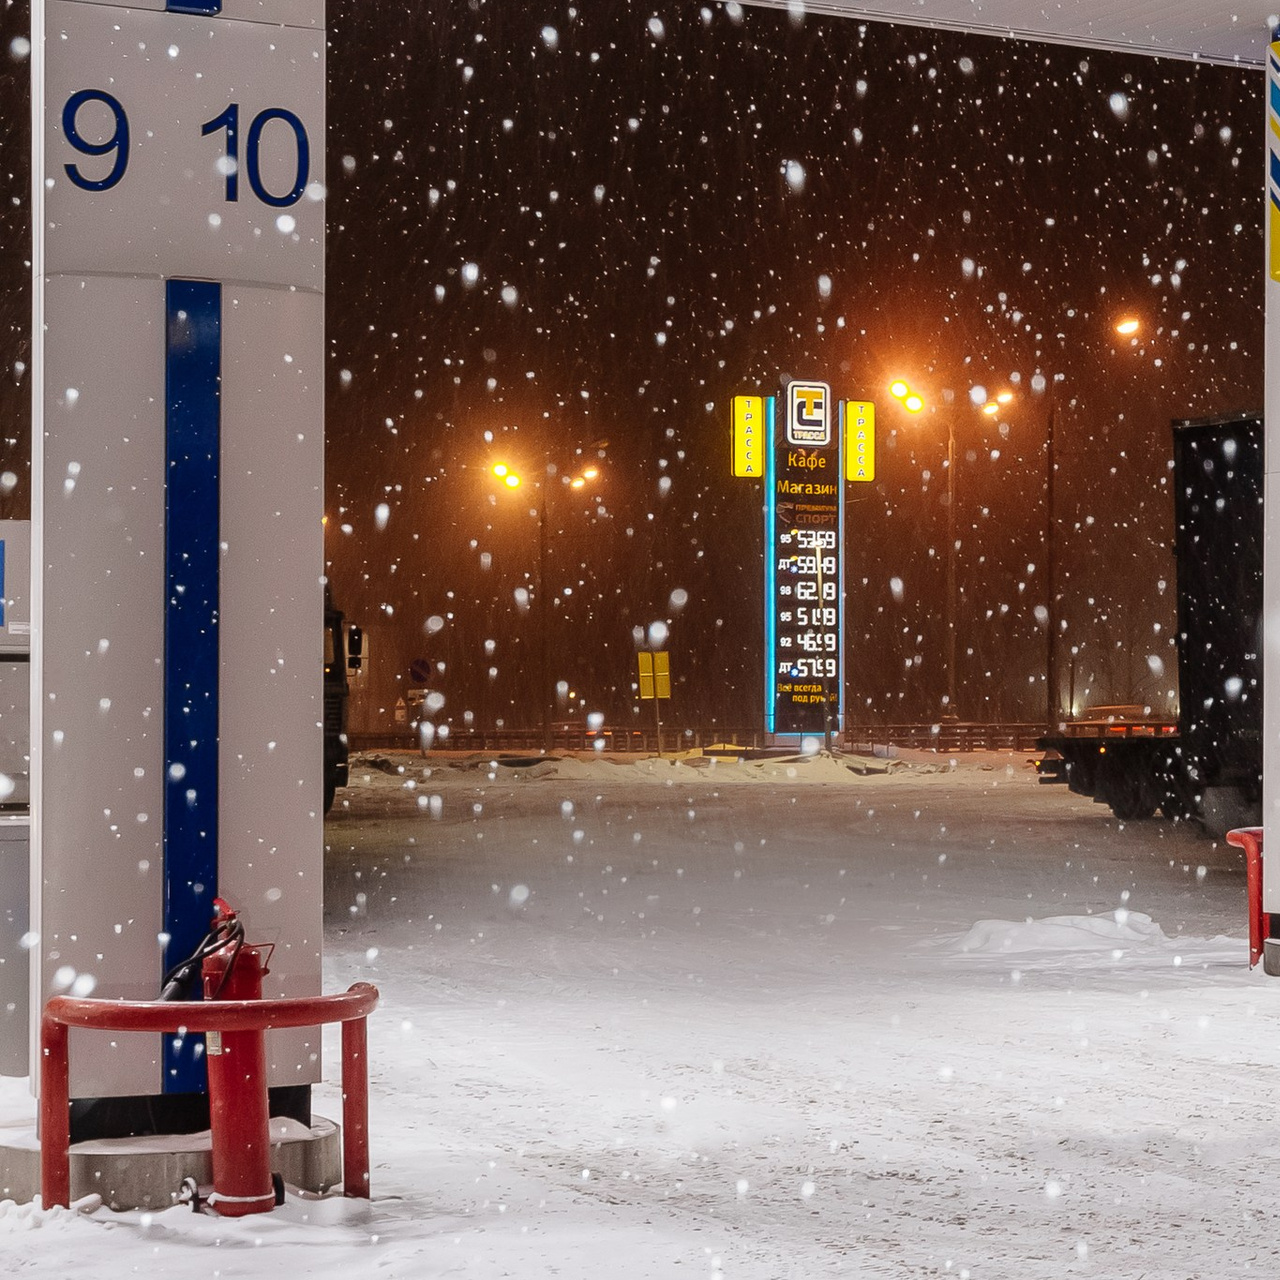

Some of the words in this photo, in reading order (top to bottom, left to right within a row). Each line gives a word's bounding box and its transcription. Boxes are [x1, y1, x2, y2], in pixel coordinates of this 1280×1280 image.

[62, 88, 130, 192] 9
[201, 103, 310, 208] 10
[745, 400, 754, 473] ТРАССА
[857, 405, 866, 477] ТРАССА
[788, 452, 826, 471] Кафе
[777, 480, 837, 495] Магазин
[795, 513, 837, 525] СПОРТ
[780, 534, 792, 544] 95
[780, 611, 792, 621] 95
[780, 637, 792, 647] 92
[793, 684, 822, 693] всегда
[792, 694, 808, 703] под
